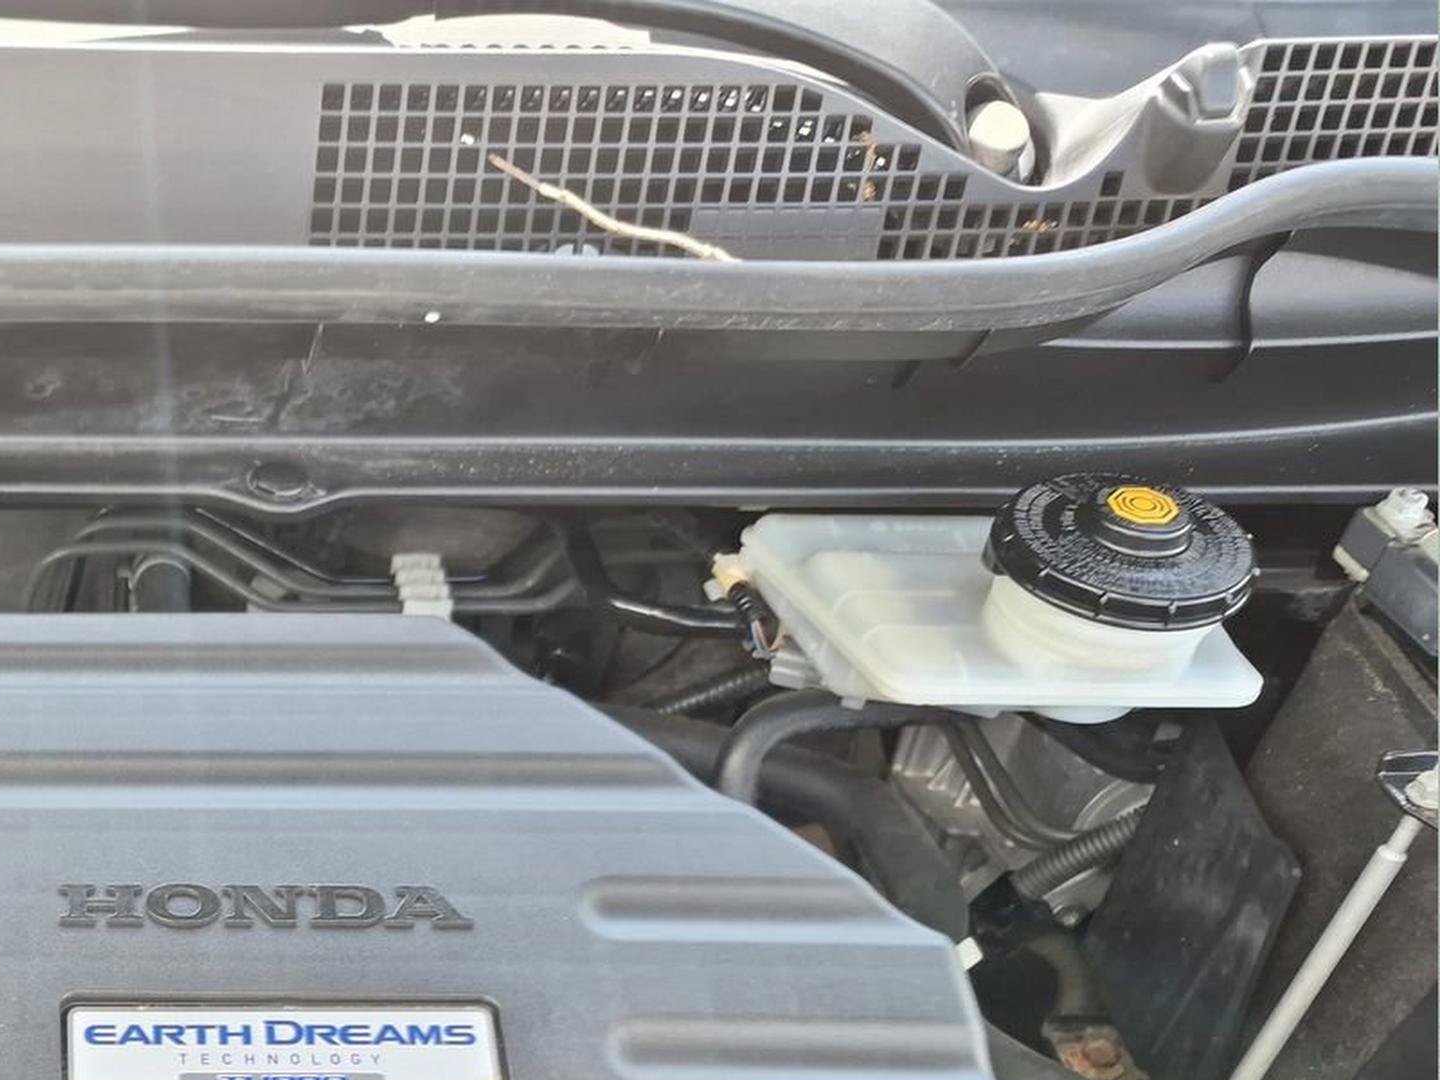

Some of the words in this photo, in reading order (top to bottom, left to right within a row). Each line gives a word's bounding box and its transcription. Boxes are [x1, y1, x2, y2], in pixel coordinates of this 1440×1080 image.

[58, 883, 474, 930] HONDA
[84, 1024, 253, 1046] EARTH
[264, 1020, 477, 1046] DREAMS
[179, 1052, 383, 1066] TECHNOLOGY
